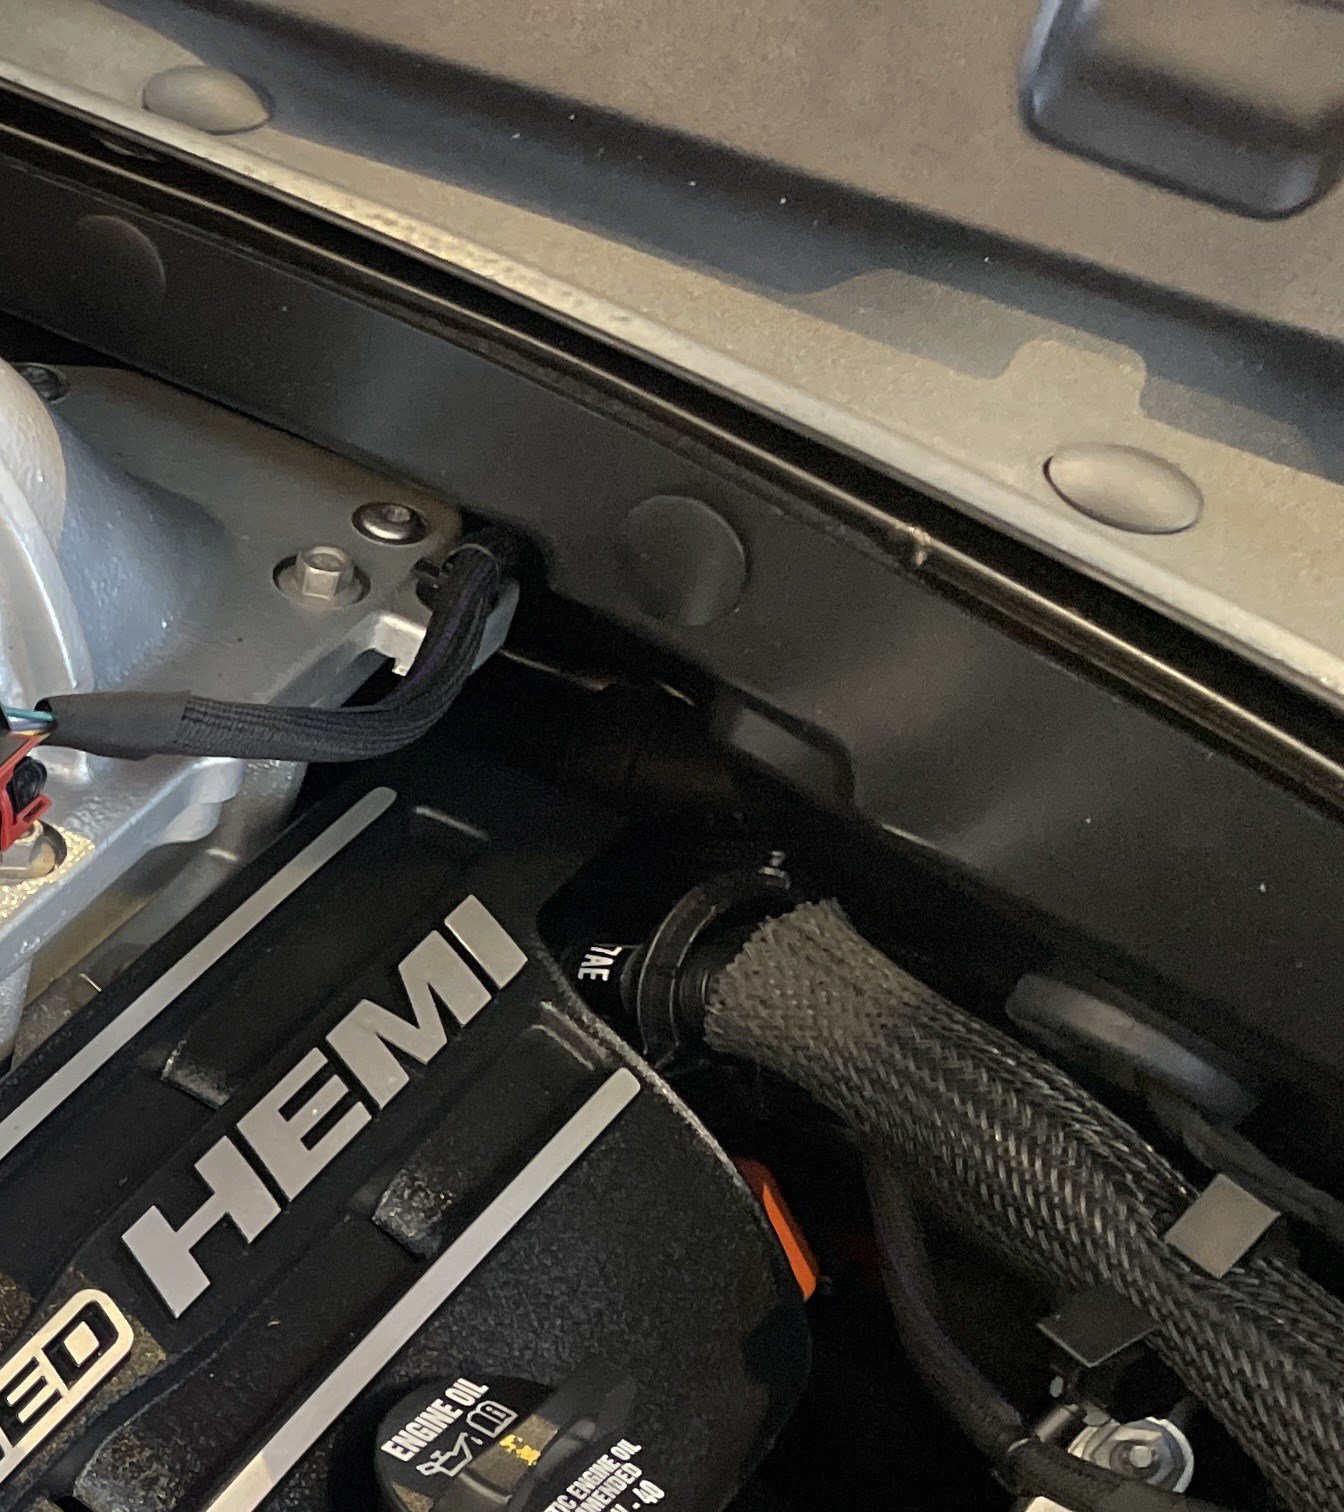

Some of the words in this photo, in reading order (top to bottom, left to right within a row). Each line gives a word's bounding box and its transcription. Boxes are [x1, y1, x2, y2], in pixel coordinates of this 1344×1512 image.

[121, 894, 528, 1318] HEMI
[381, 1398, 464, 1462] ENGINE
[445, 1378, 489, 1408] OIL
[565, 1454, 620, 1502] ENGINE
[611, 1438, 642, 1464] OIL
